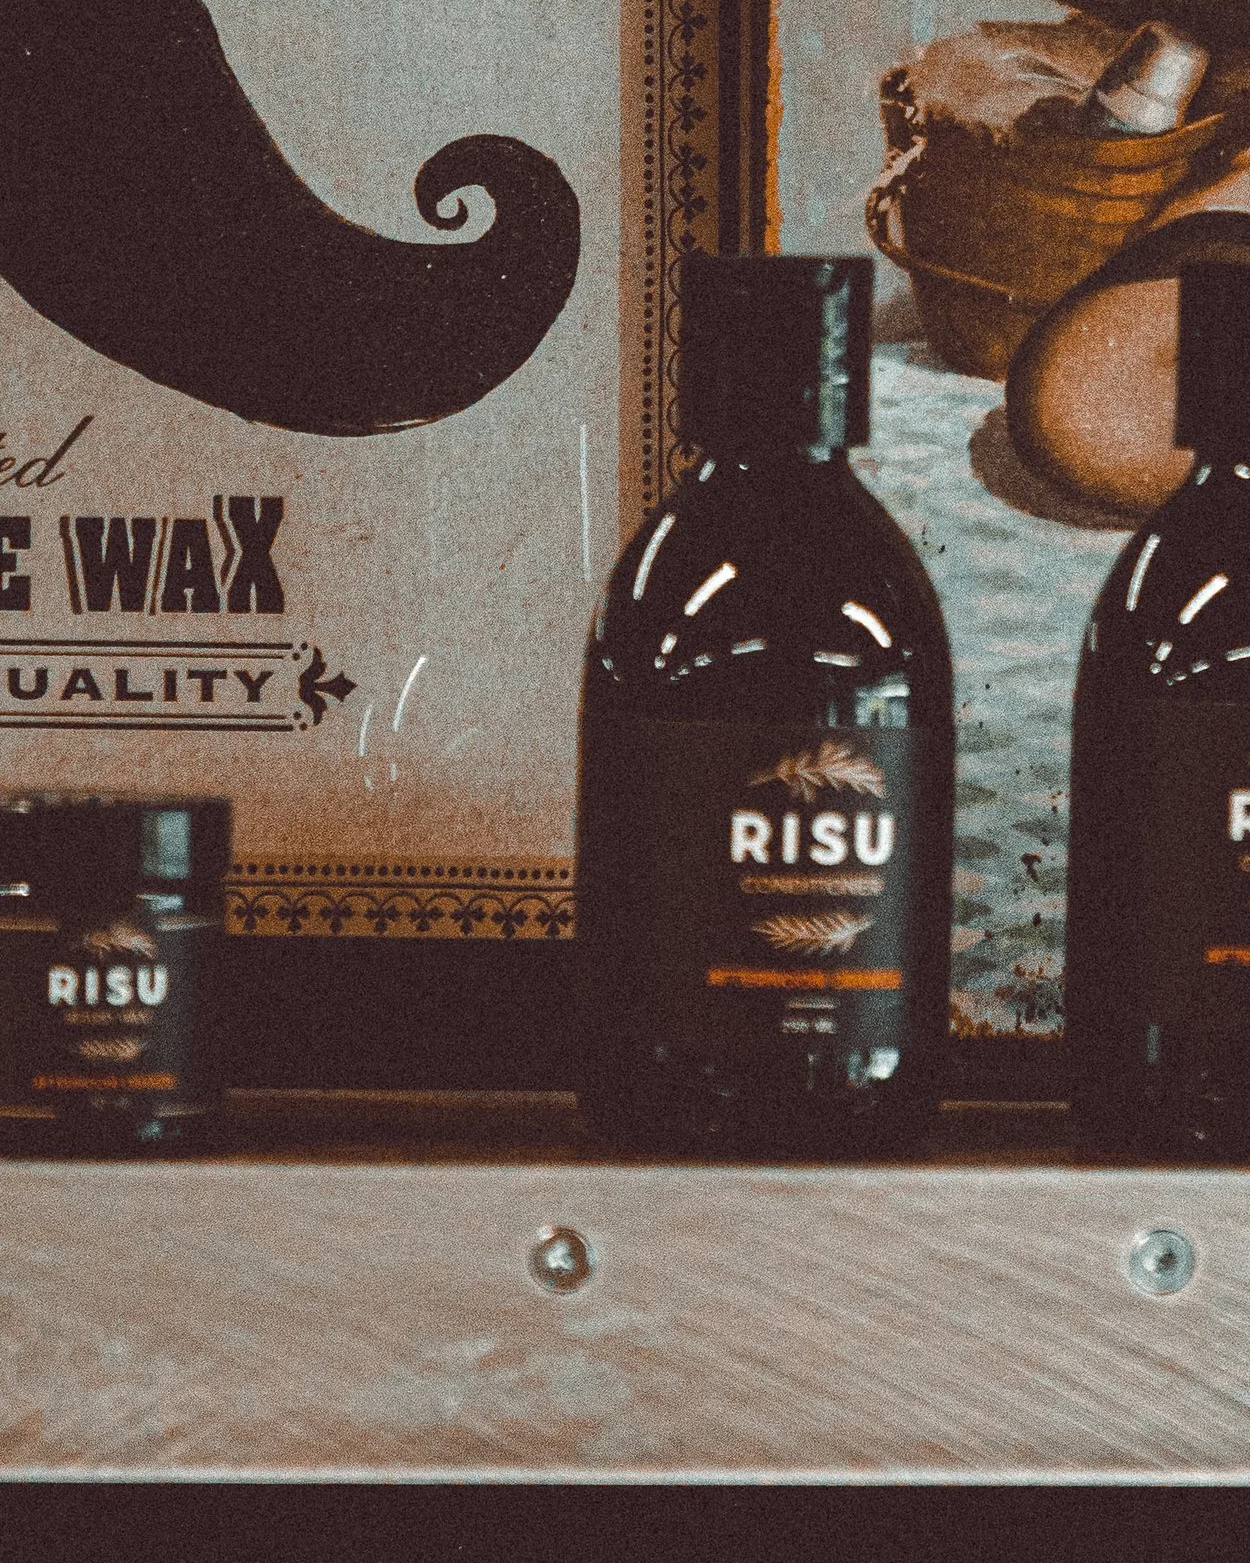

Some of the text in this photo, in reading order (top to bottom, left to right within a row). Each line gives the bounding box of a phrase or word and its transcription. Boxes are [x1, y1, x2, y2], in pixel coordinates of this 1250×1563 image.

[0, 415, 94, 488] ed
[59, 495, 285, 616] WAX
[731, 809, 895, 865] RISU
[49, 966, 168, 1005] RISU
